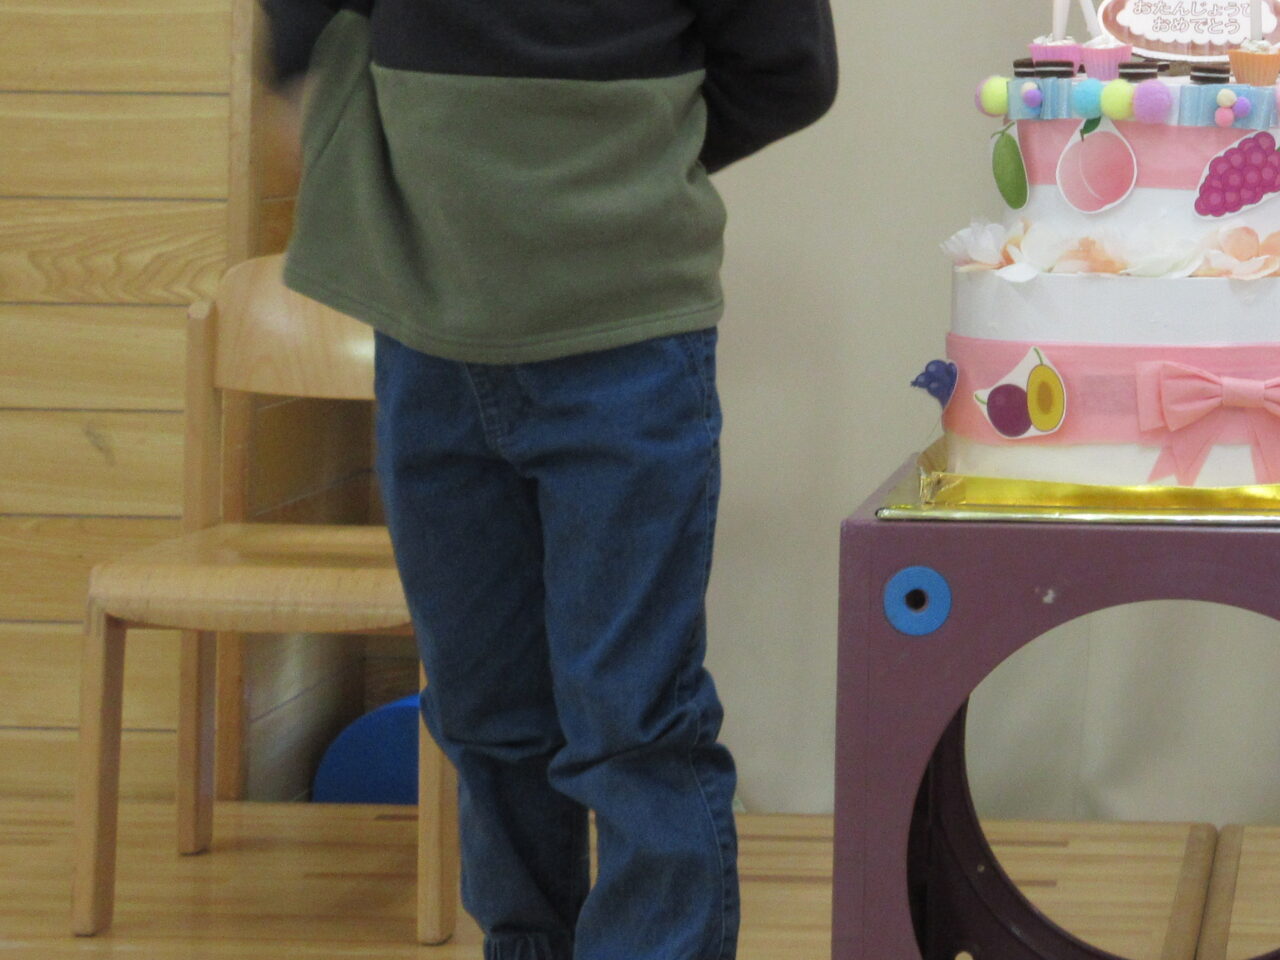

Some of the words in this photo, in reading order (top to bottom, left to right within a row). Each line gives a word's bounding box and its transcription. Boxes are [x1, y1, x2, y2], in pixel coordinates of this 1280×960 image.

[1152, 17, 1241, 34] おめでとう
